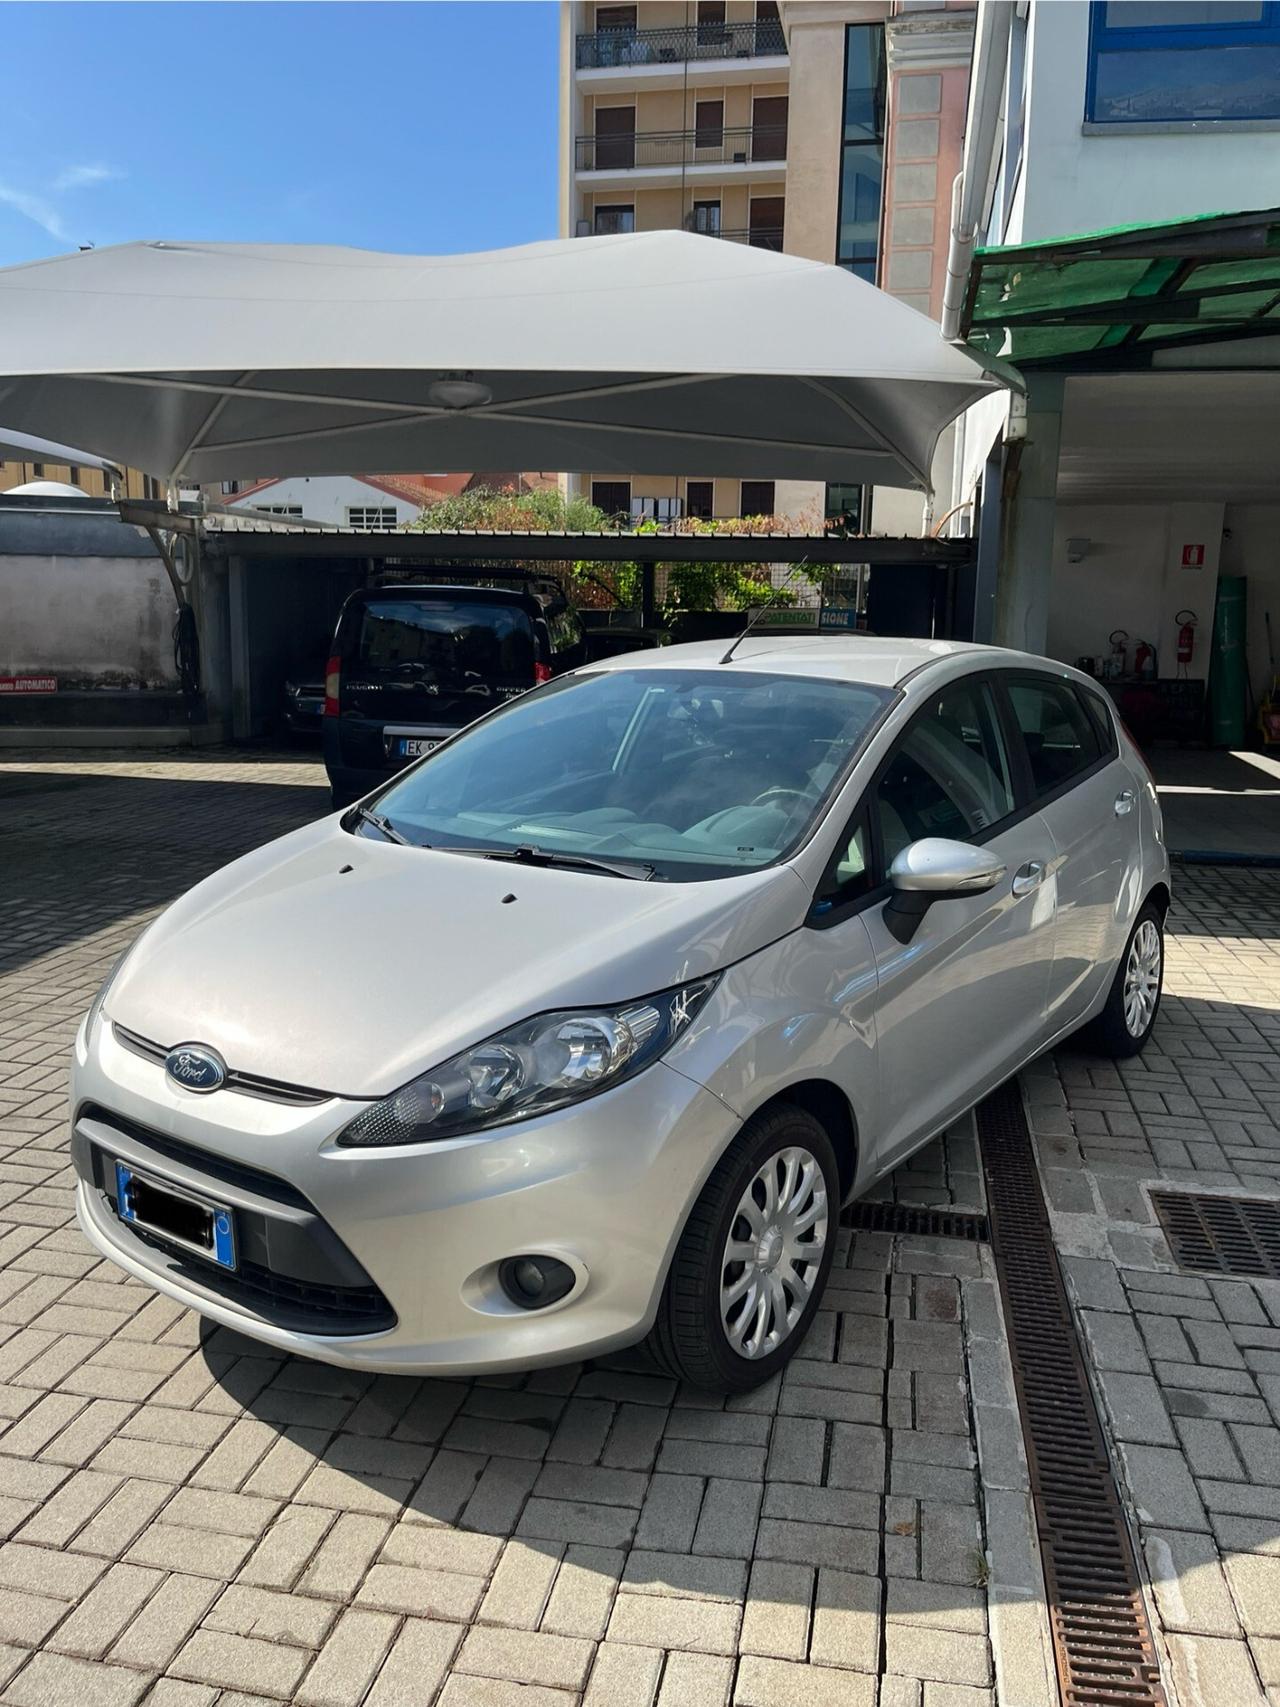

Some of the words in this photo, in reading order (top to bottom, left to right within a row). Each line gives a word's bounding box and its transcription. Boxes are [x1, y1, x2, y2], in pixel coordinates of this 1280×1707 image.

[821, 611, 849, 625] SIONE
[15, 679, 56, 690] AUTOMATICO
[408, 741, 422, 755] EK
[173, 1053, 207, 1083] Ford
